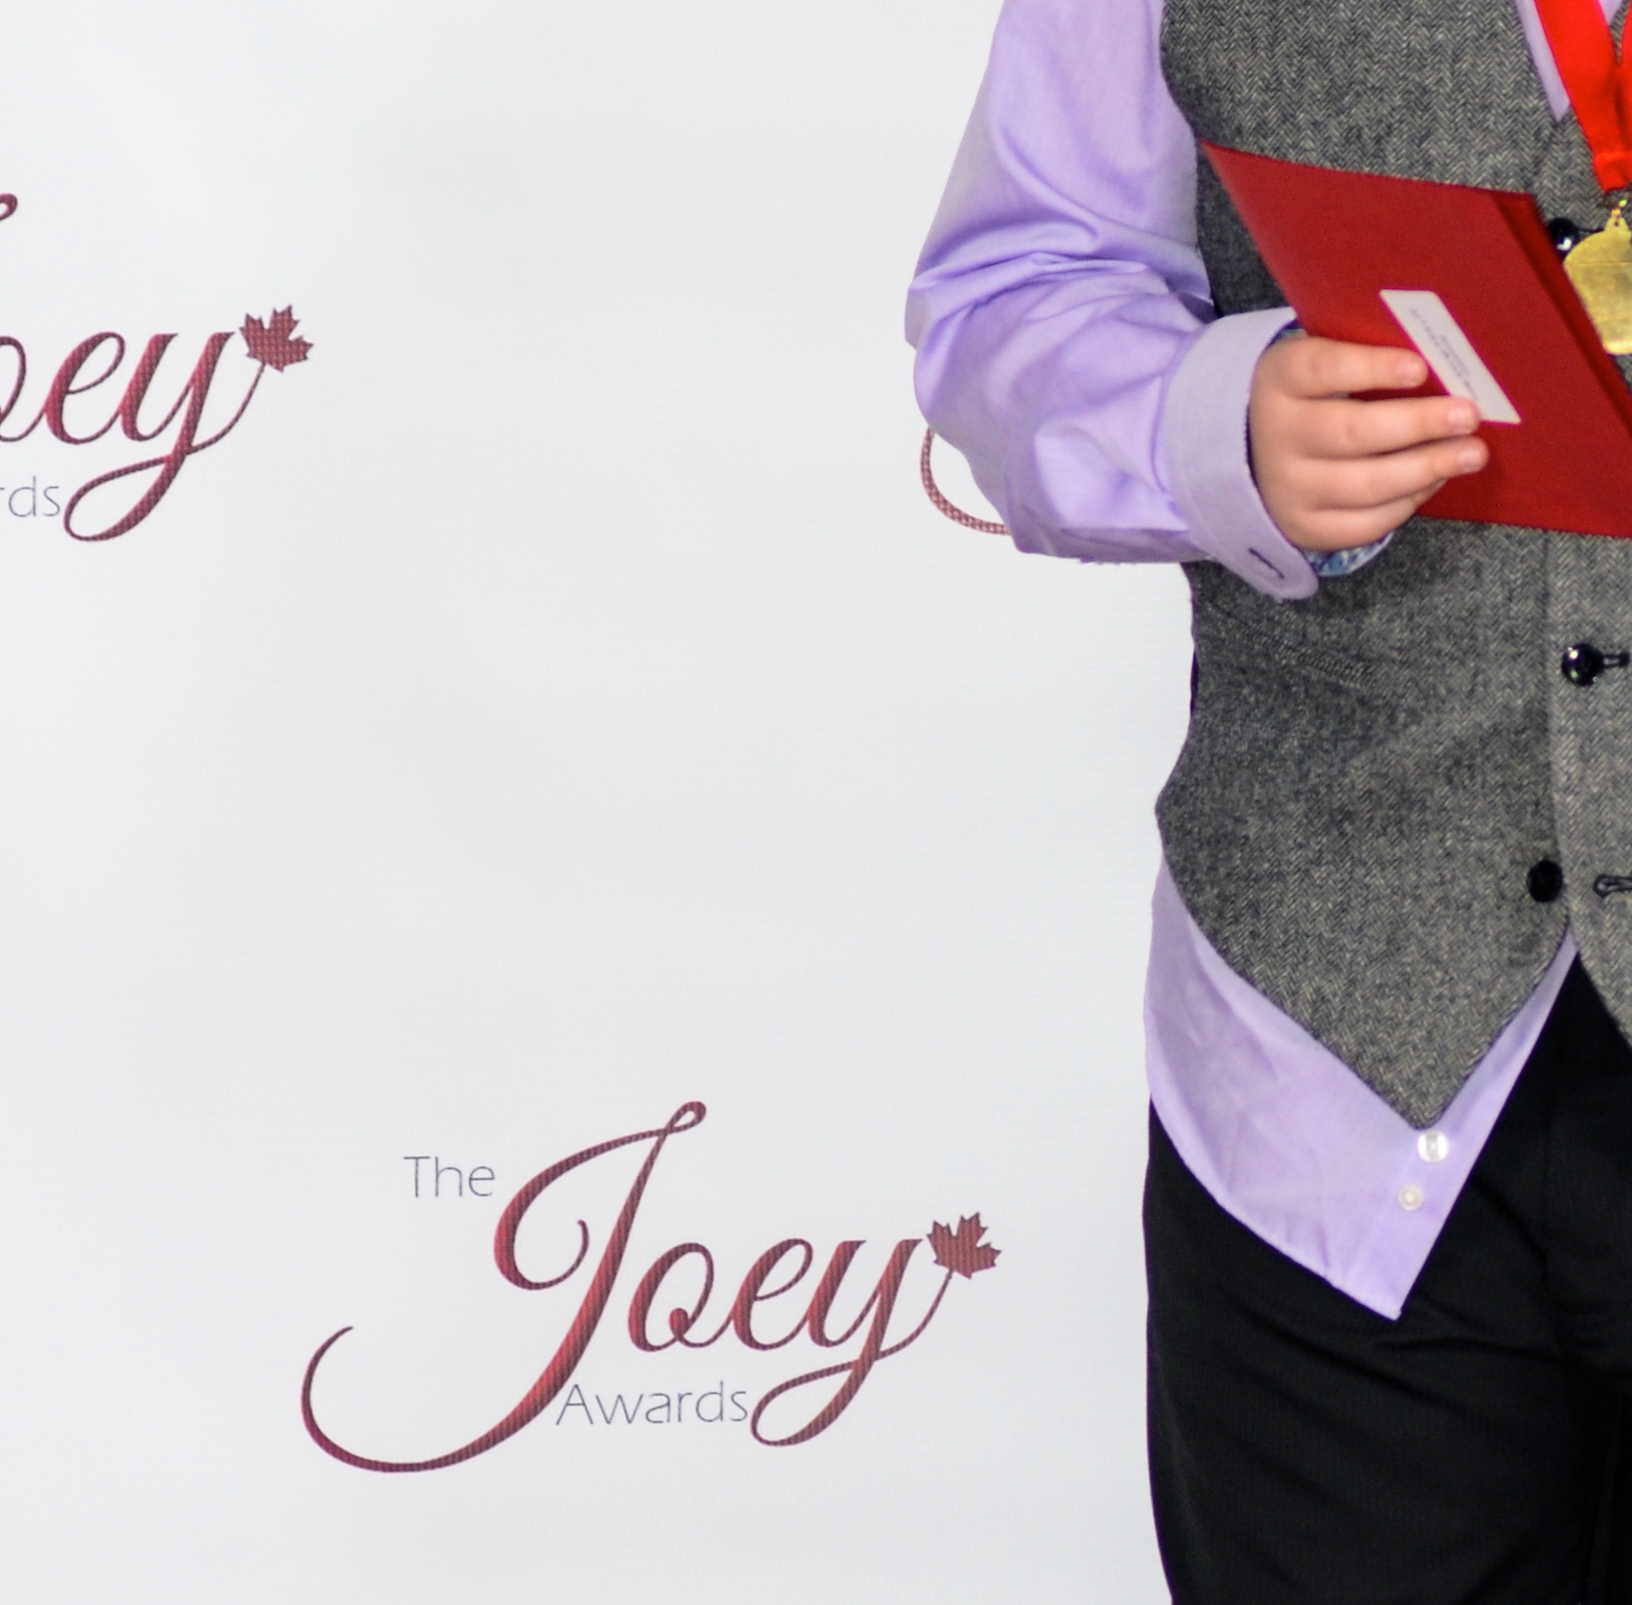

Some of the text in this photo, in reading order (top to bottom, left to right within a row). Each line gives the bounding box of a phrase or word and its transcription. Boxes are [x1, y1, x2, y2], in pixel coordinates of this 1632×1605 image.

[301, 1101, 951, 1473] The Joey
[556, 1381, 749, 1426] Awards
